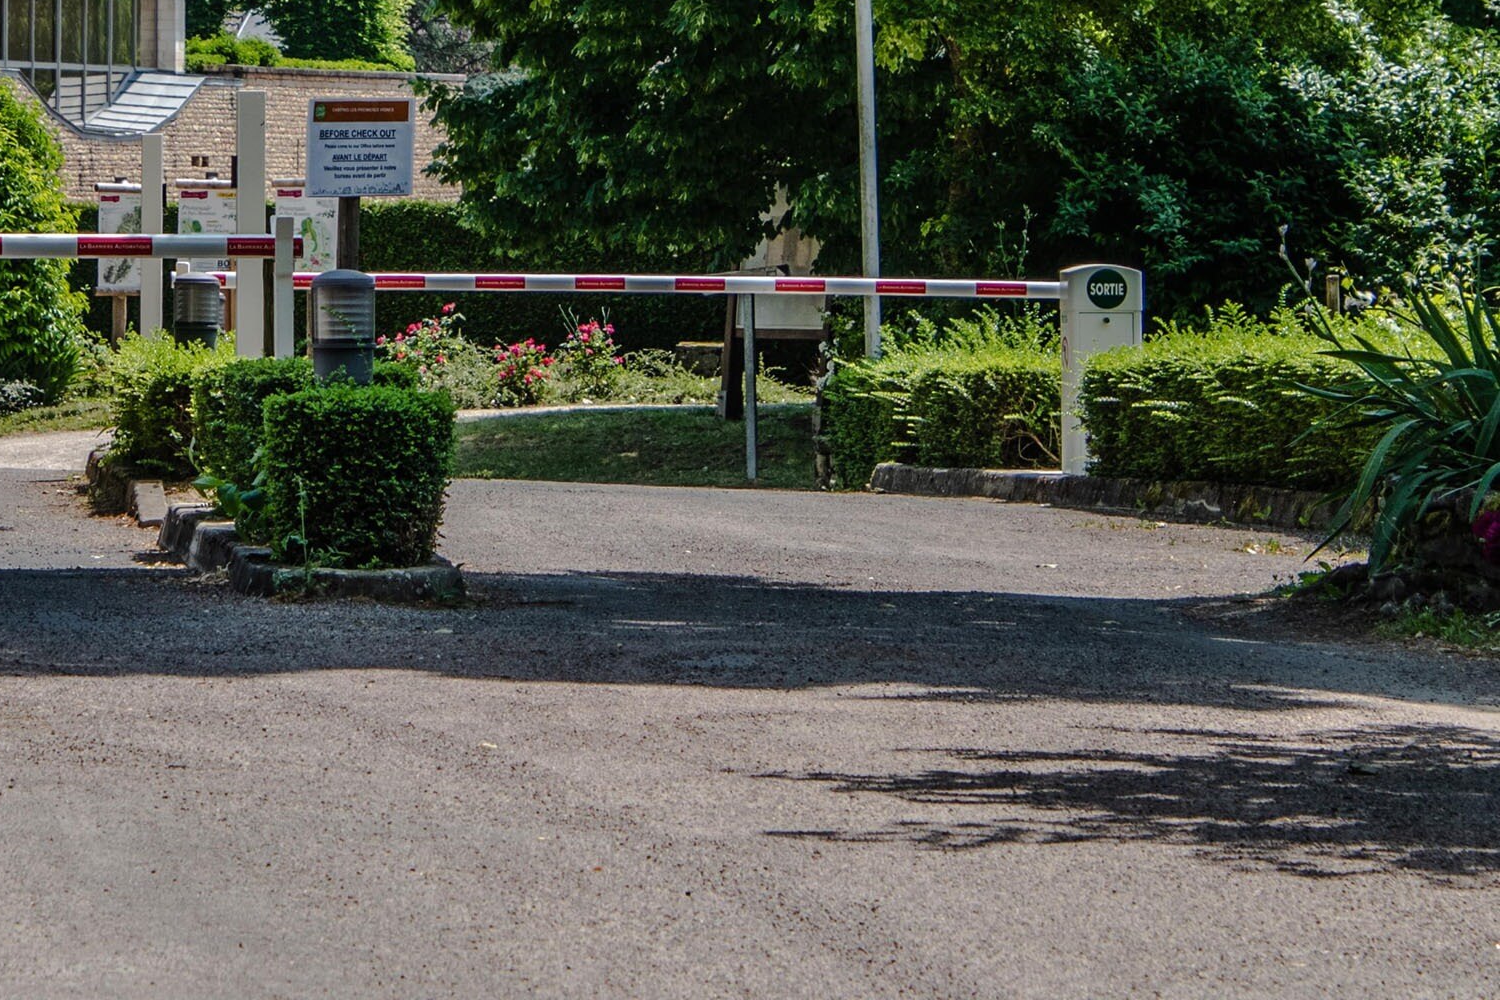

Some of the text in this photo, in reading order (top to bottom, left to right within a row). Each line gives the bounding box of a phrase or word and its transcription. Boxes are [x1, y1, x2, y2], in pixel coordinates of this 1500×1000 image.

[319, 129, 396, 138] BEFORE CHECK OUT
[363, 152, 387, 160] DÉPART
[1090, 283, 1124, 295] SORTIE
